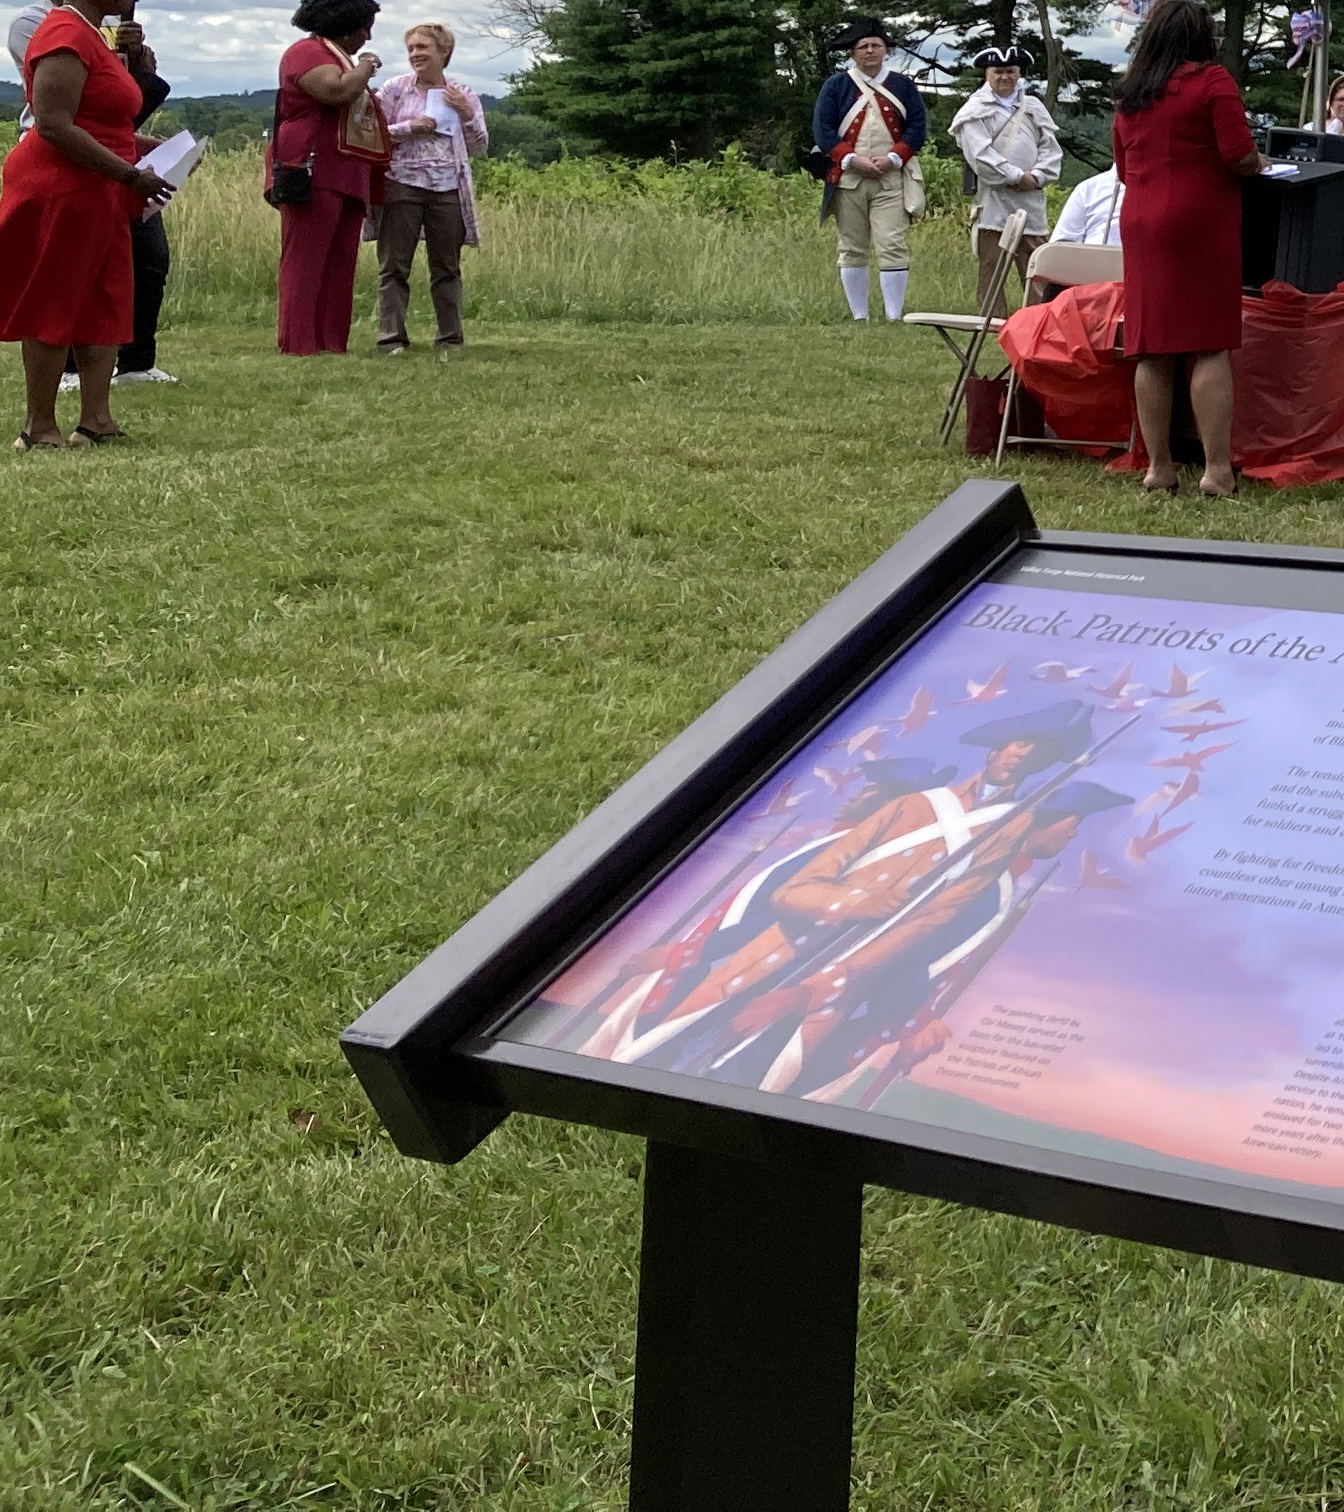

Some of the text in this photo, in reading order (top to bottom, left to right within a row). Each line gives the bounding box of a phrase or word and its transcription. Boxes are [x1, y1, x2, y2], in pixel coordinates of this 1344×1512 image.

[964, 603, 1071, 636] Black
[1074, 614, 1224, 651] Patriots
[1228, 632, 1276, 655] of
[1268, 635, 1325, 661] the
[1313, 734, 1331, 744] of
[1287, 766, 1310, 777] The
[1270, 783, 1297, 793] and
[1296, 785, 1317, 796] the
[1256, 798, 1298, 811] fueled
[1242, 814, 1263, 826] for
[1262, 818, 1312, 832] soldiers
[1312, 825, 1340, 835] and
[1213, 848, 1231, 860] By
[1231, 850, 1281, 869] fighting
[1280, 857, 1303, 869] for
[1199, 868, 1257, 882] countless
[1258, 875, 1294, 887] other
[1294, 881, 1343, 897] unsung
[1183, 883, 1223, 897] future
[1220, 890, 1297, 907] generations
[1297, 899, 1312, 910] in
